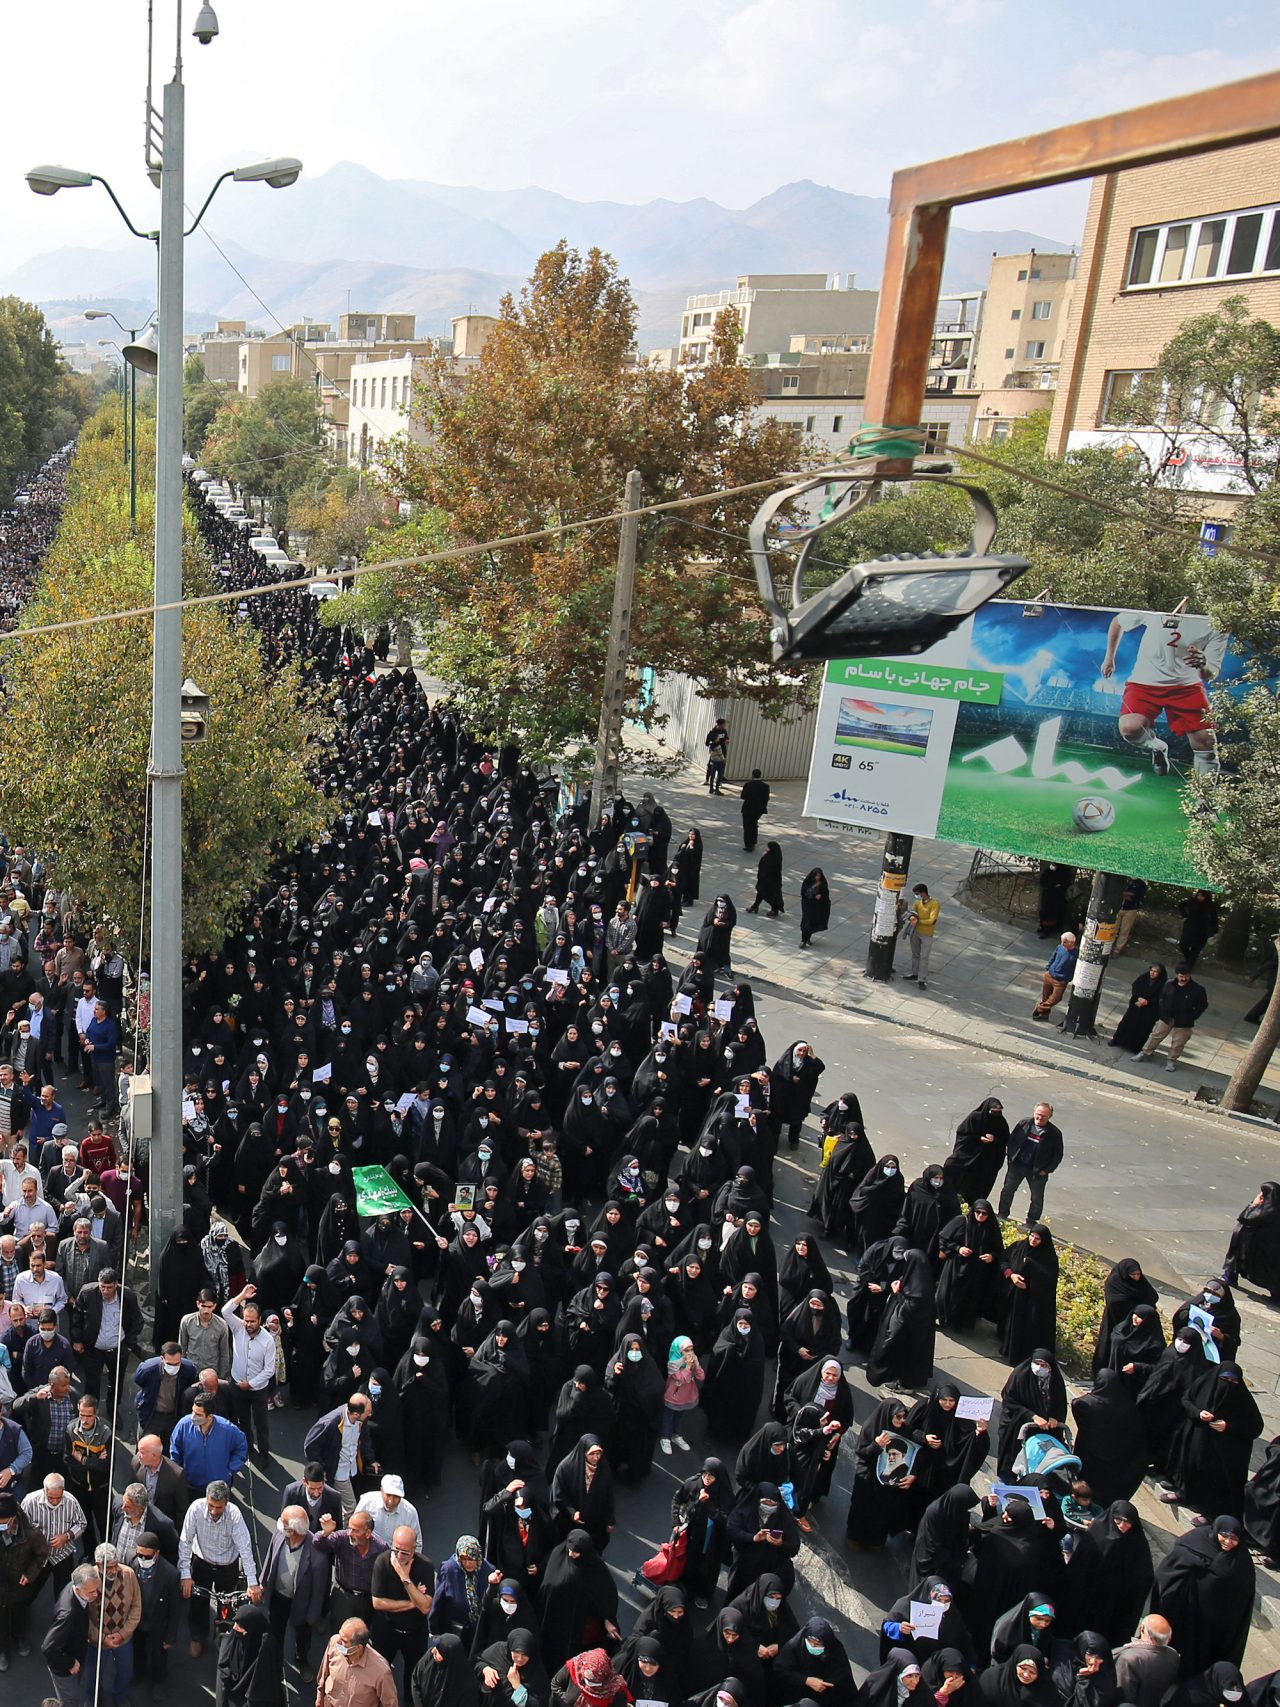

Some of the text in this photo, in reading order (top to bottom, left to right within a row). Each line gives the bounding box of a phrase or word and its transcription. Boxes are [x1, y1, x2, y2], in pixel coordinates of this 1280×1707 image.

[1167, 632, 1182, 648] 2
[844, 664, 990, 695] جام جهانی با سام
[834, 755, 849, 763] 4K
[962, 715, 1143, 790] سام
[829, 788, 859, 802] سام
